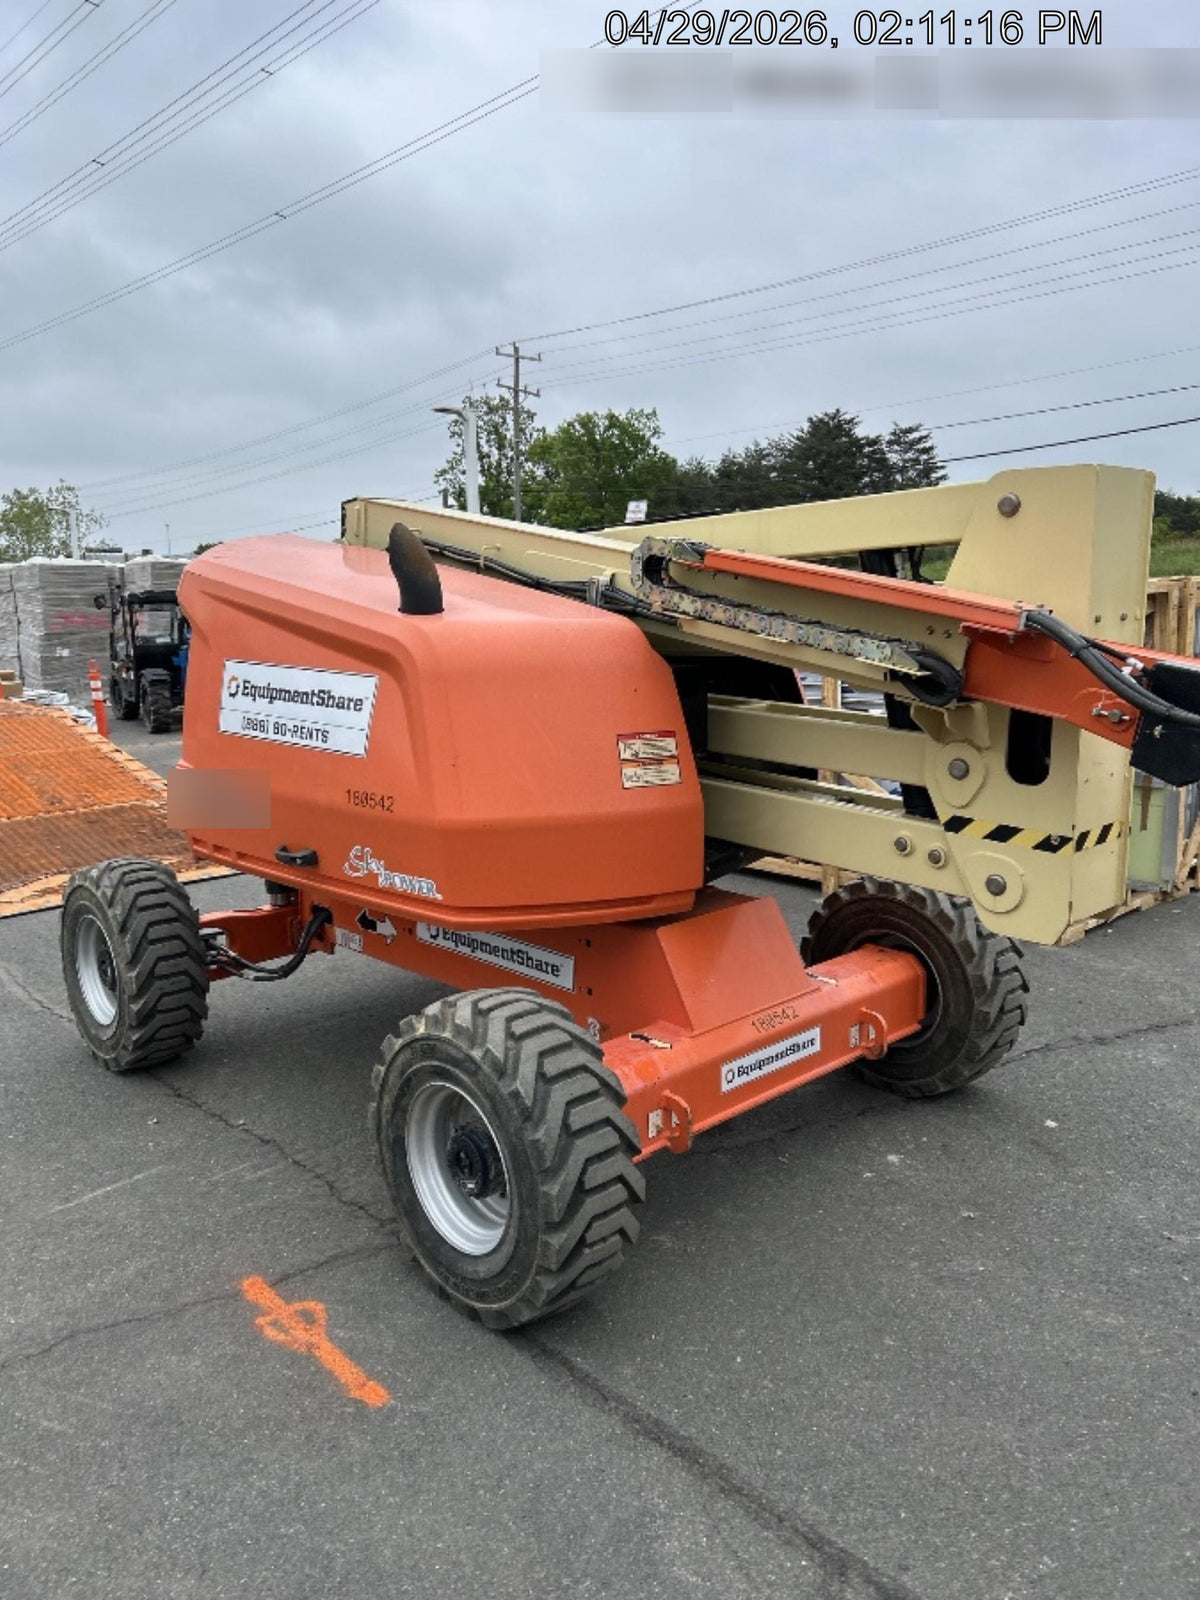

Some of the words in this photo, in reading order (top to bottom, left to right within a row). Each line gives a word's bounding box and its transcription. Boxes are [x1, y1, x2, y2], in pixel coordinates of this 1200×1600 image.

[241, 679, 363, 712] EquipmentShare
[345, 788, 394, 813] 180542
[442, 927, 561, 978] EquipmentShare
[737, 1037, 815, 1078] EquipmentShare
